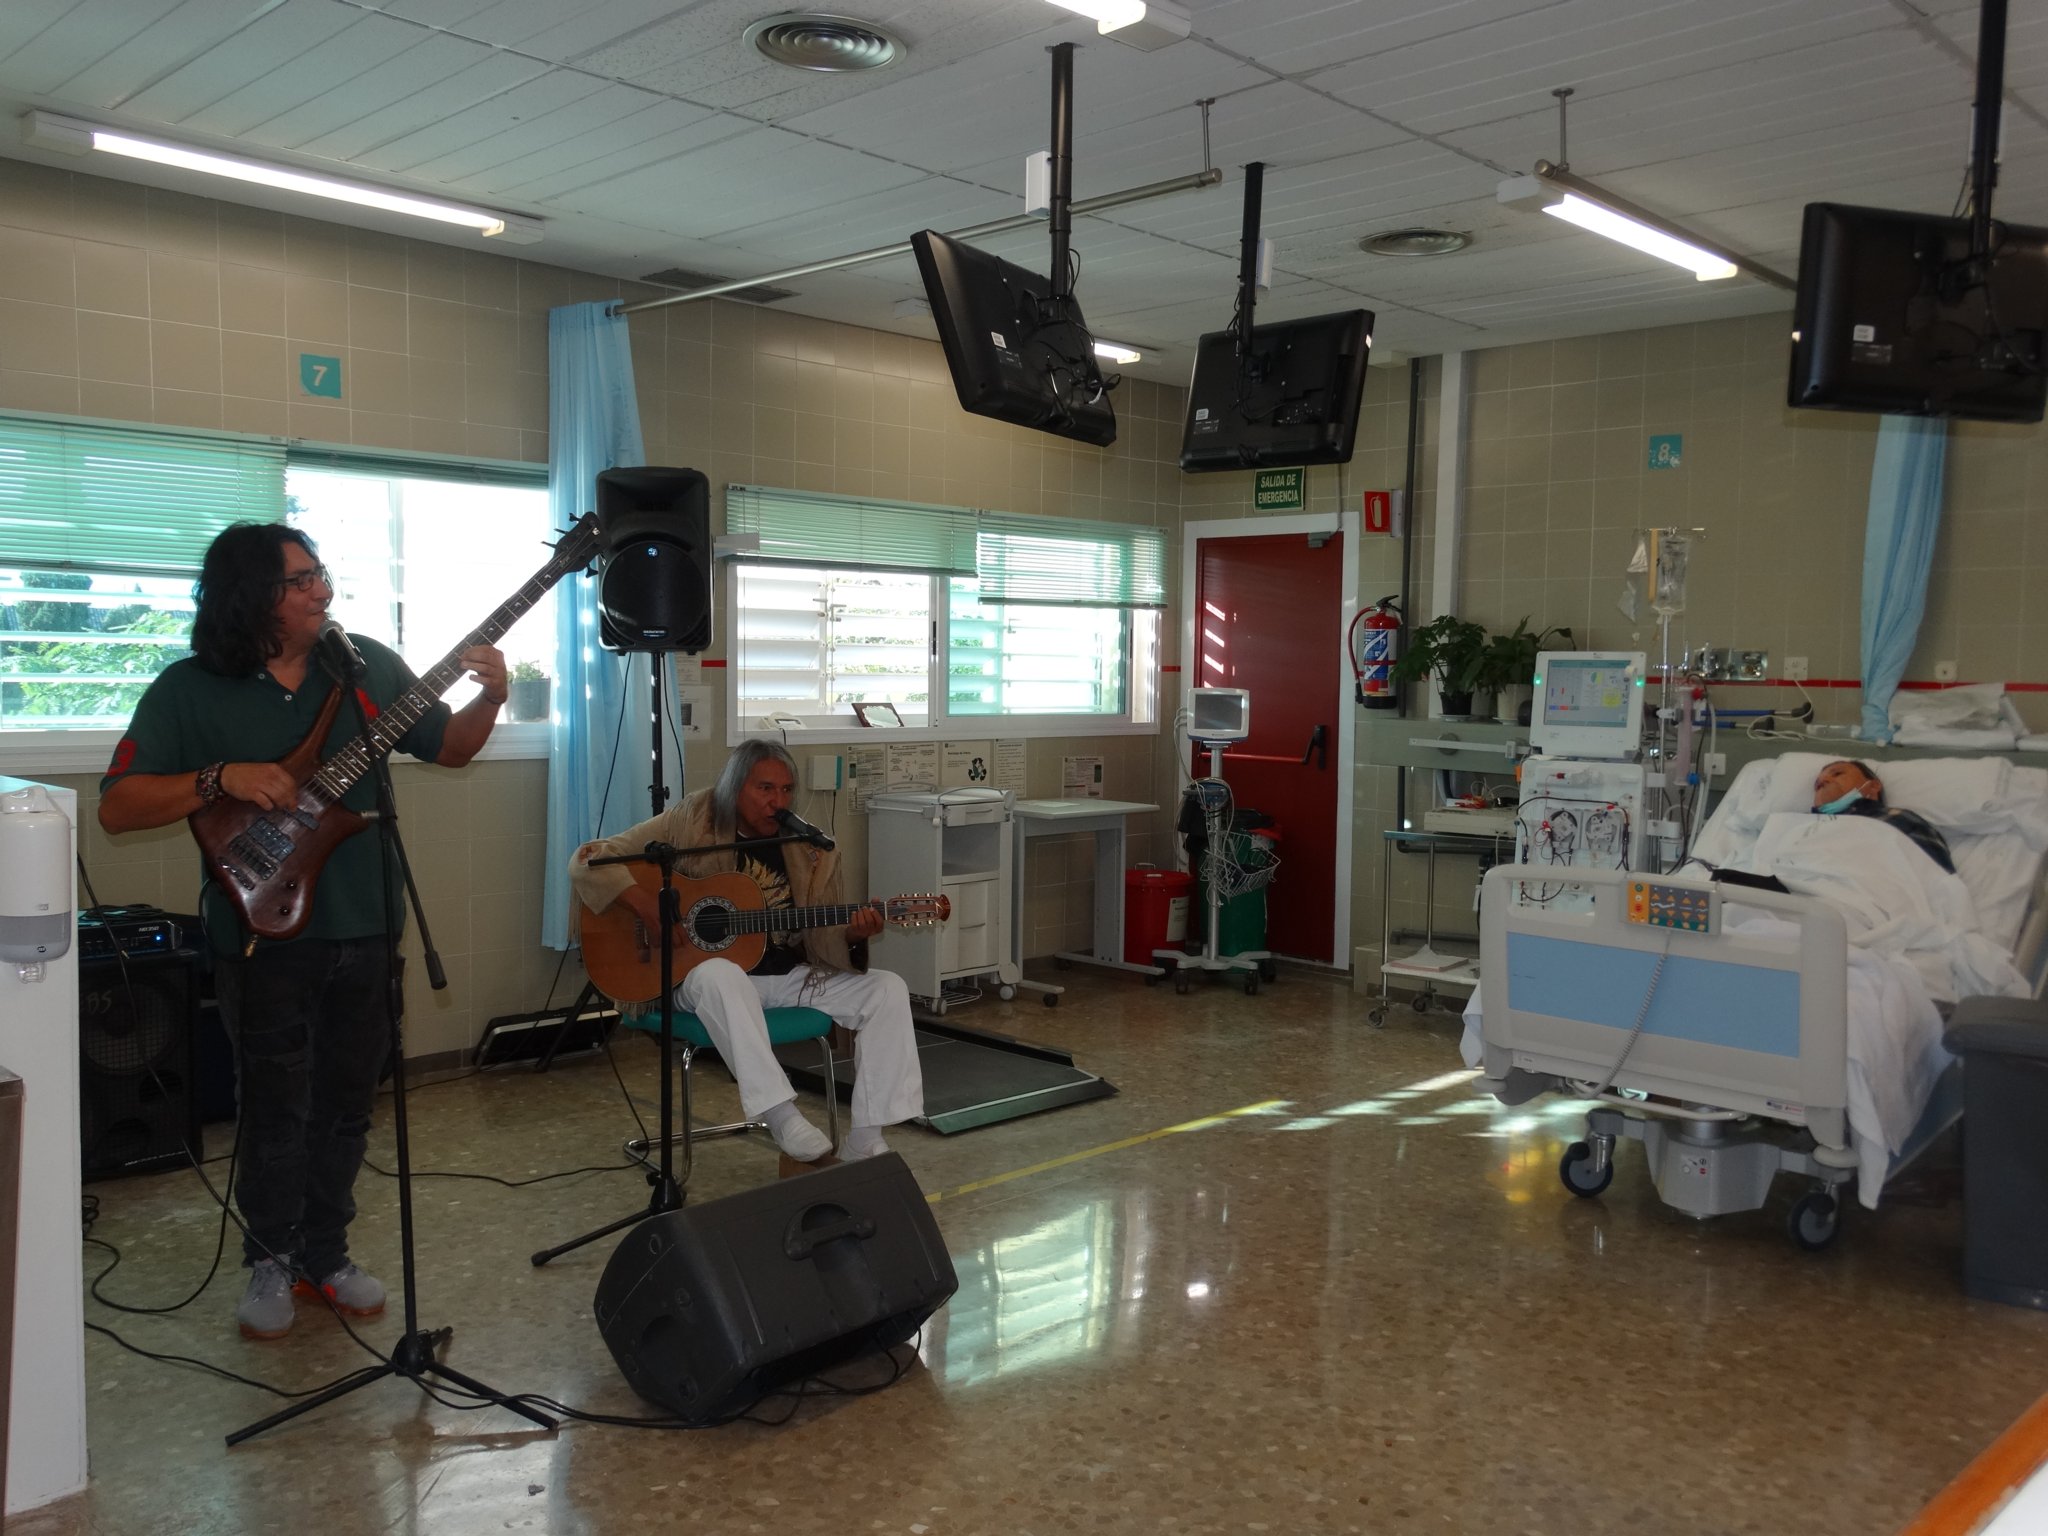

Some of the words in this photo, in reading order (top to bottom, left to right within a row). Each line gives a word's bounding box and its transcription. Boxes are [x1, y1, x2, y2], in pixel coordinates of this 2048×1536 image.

[312, 365, 328, 387] 7
[1260, 475, 1285, 489] SALIDA
[1286, 474, 1297, 486] DE
[1258, 489, 1299, 504] EMERGENCIA
